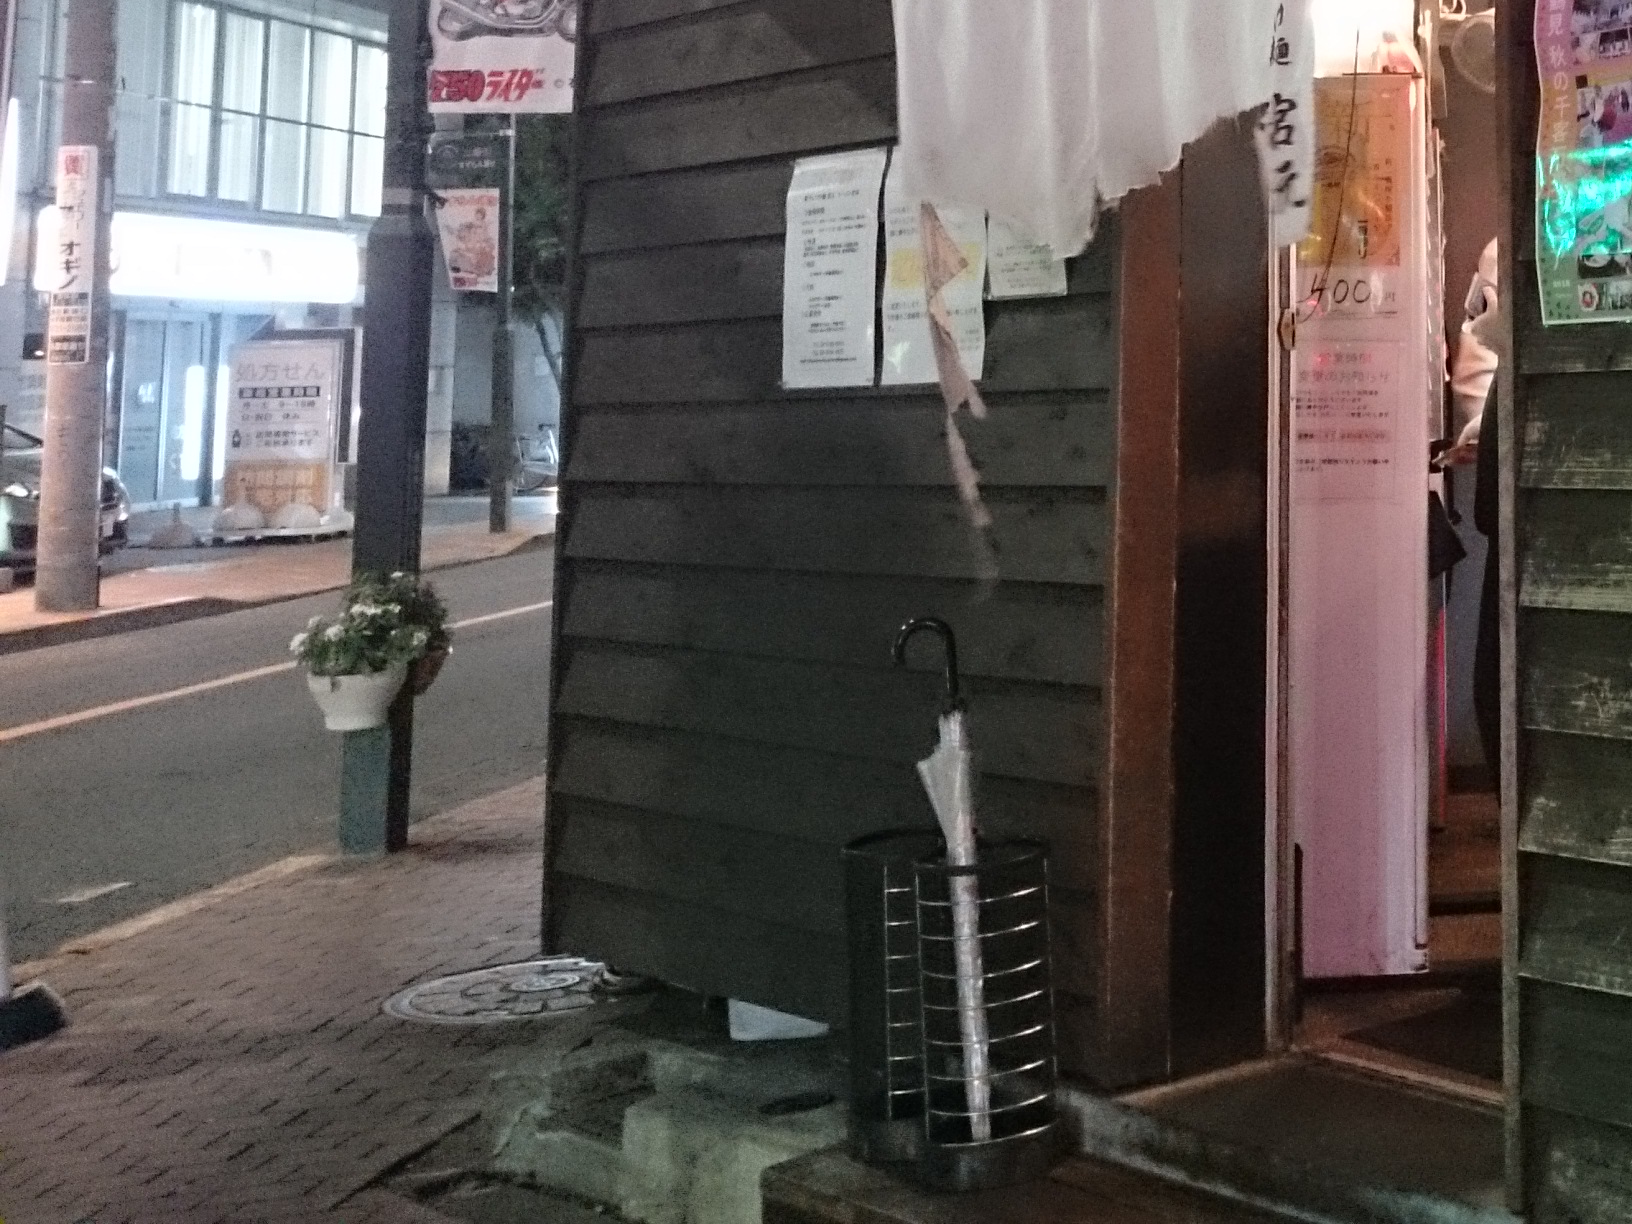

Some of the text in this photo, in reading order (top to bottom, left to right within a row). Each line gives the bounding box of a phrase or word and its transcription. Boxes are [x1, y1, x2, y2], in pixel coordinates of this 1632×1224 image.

[1258, 92, 1307, 209] 宮元
[236, 363, 325, 383] 処方せん
